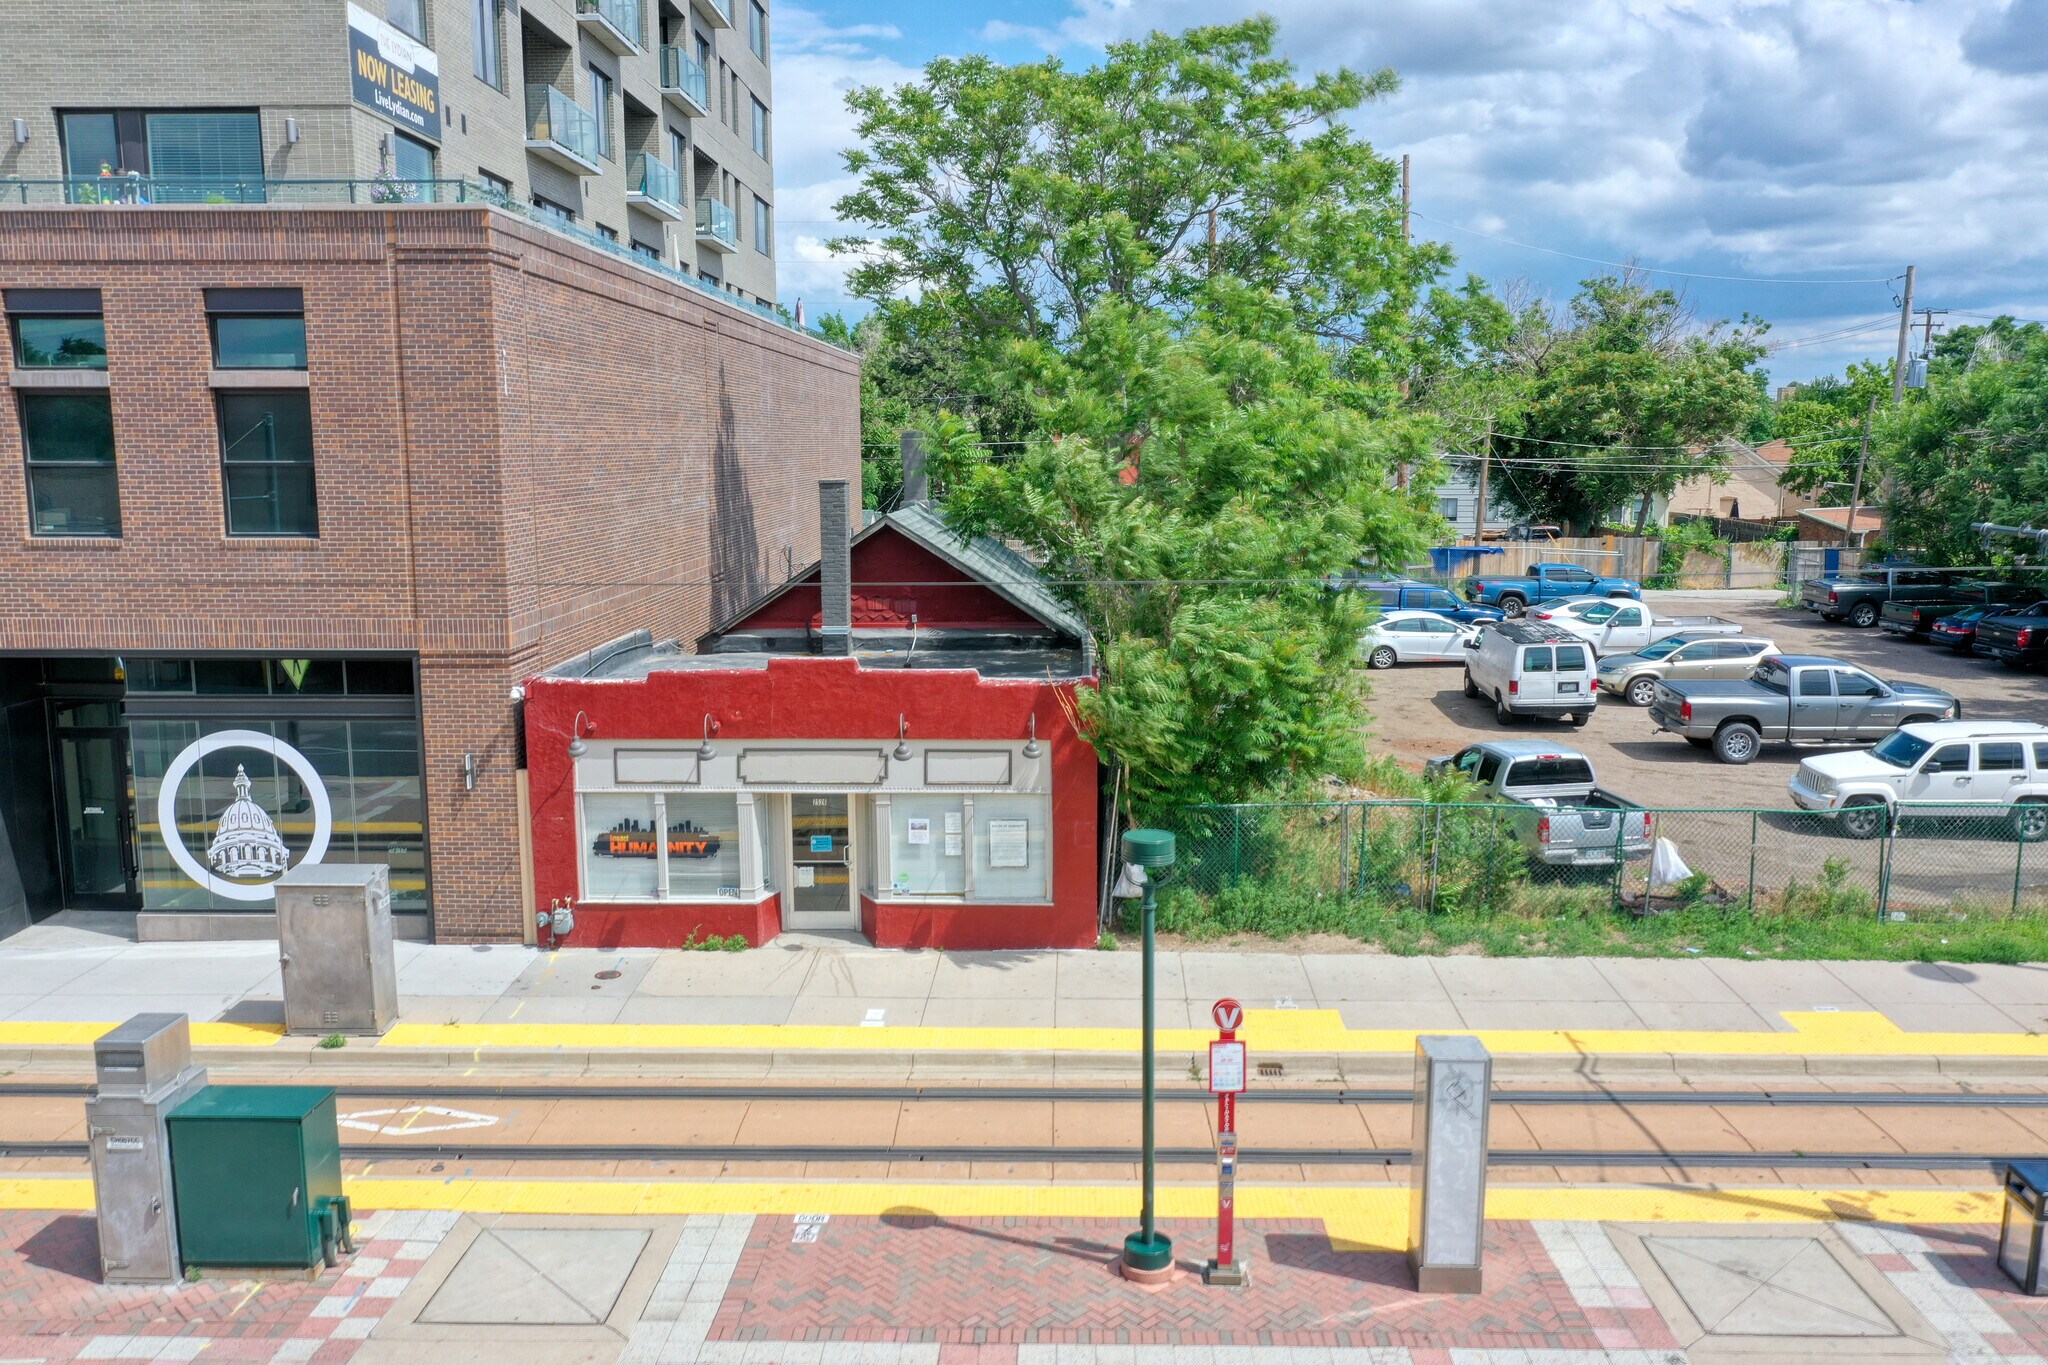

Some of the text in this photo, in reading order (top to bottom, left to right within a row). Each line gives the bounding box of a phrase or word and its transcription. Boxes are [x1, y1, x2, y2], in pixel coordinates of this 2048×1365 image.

[357, 49, 435, 114] NOW LEASING
[374, 89, 424, 126] LiveLydian.com
[718, 888, 738, 896] OPEN
[1217, 1007, 1240, 1029] V
